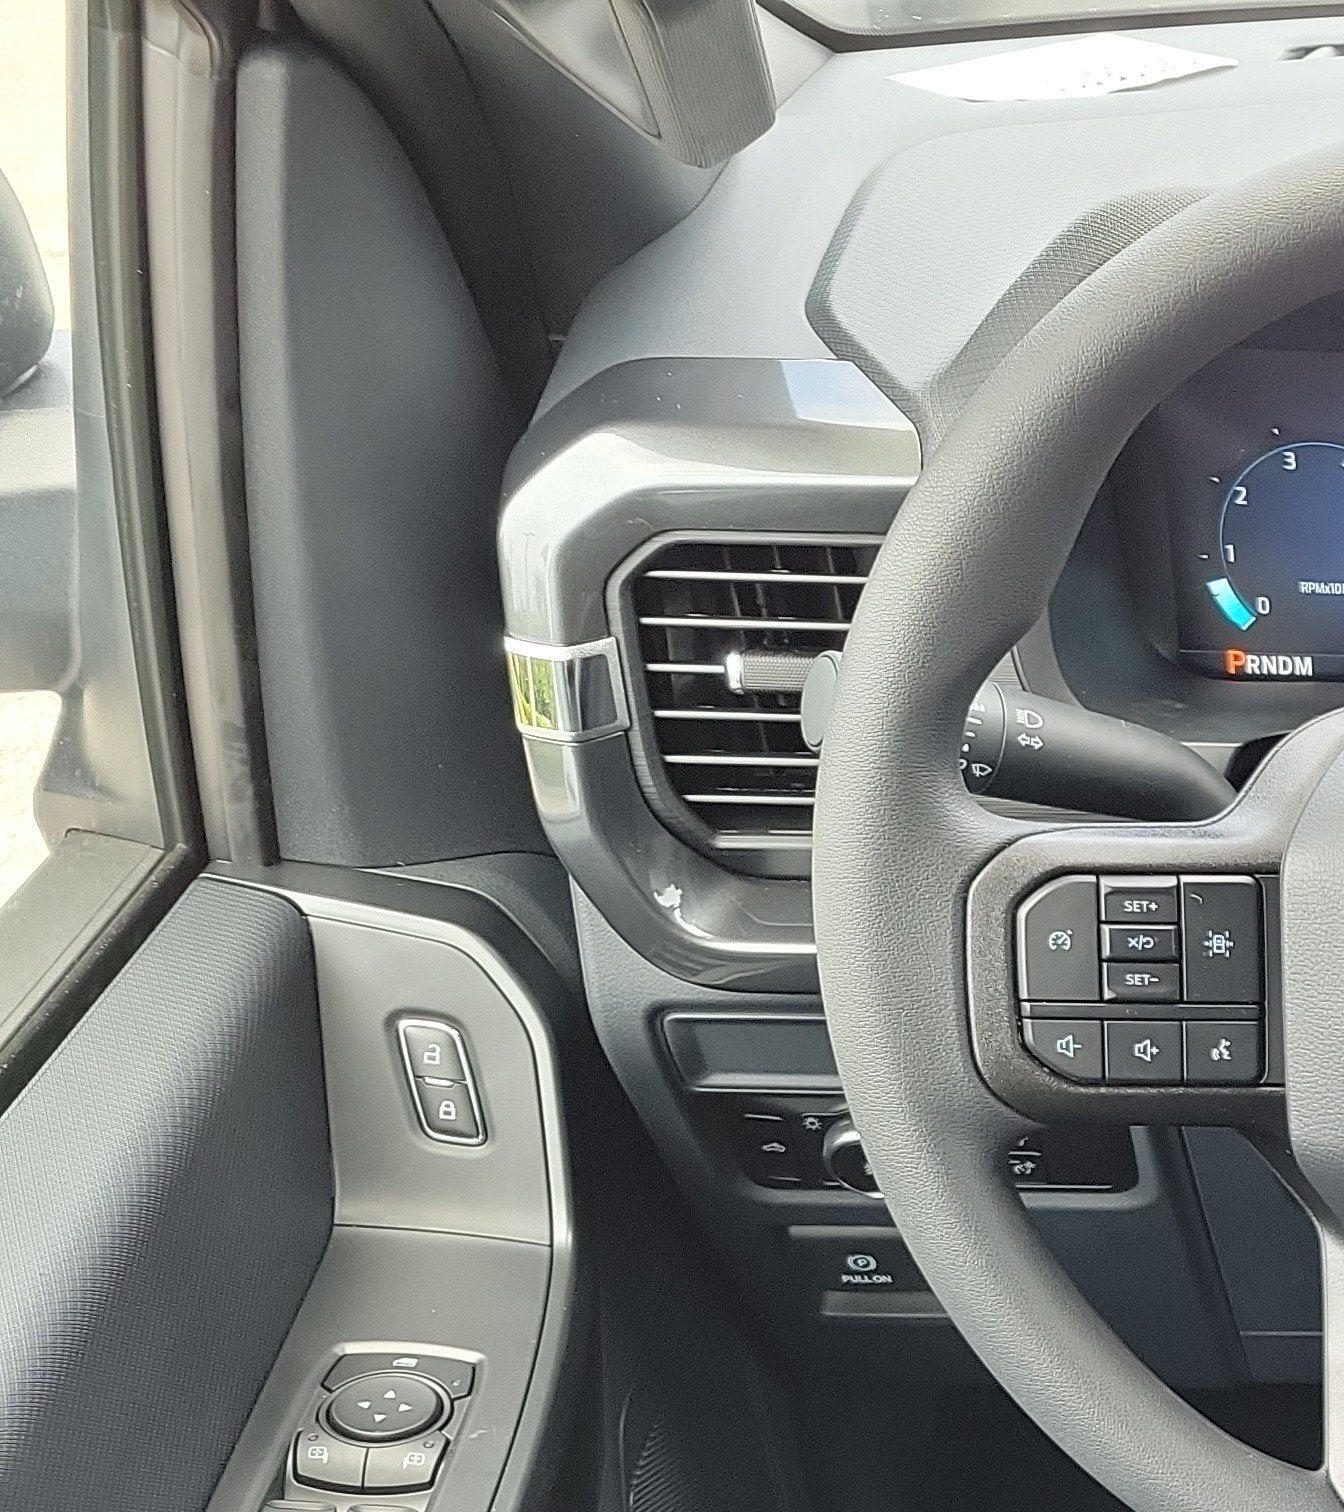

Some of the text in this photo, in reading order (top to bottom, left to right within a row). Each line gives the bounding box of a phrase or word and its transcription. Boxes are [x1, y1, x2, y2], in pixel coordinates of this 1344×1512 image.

[1282, 451, 1297, 471] 3
[1234, 486, 1248, 505] 2
[1224, 544, 1236, 563] 1
[1256, 597, 1270, 615] 0
[1124, 900, 1159, 913] SET+
[841, 1274, 893, 1284] PULL ON
